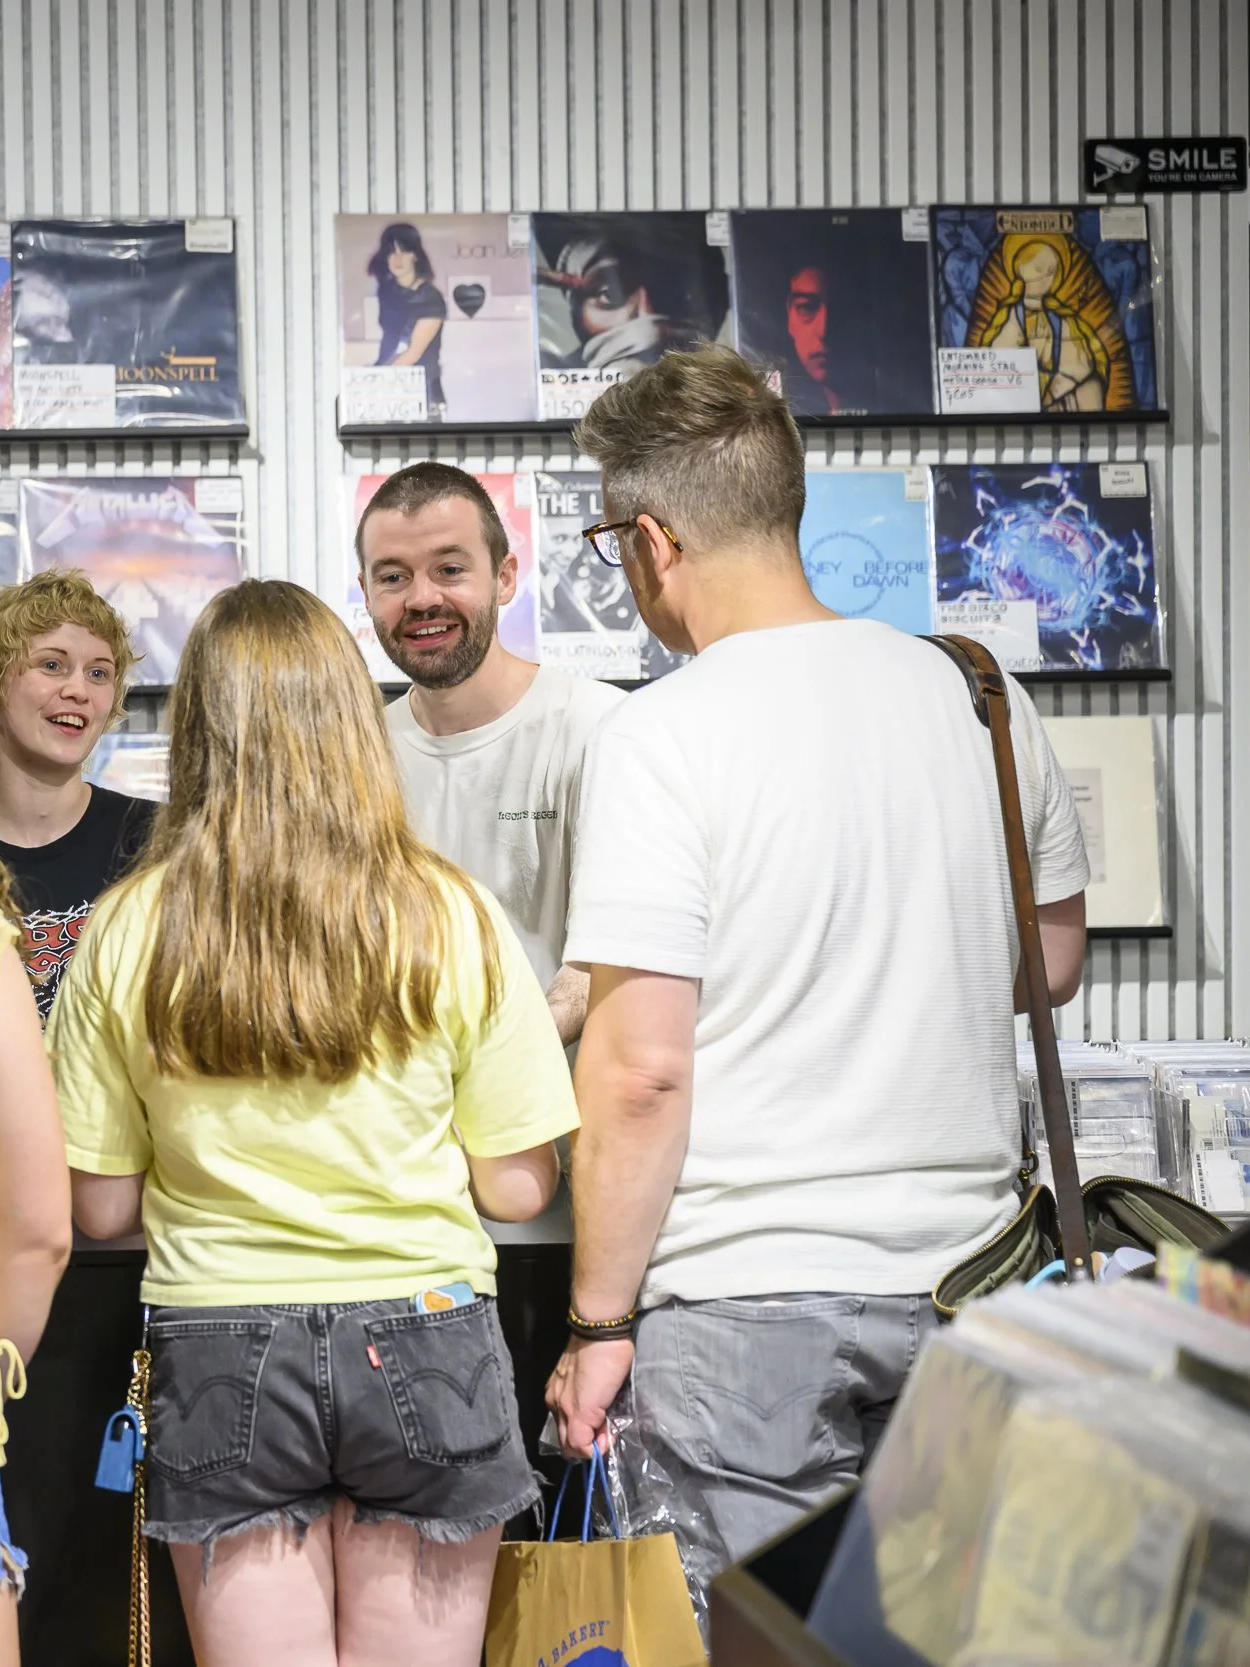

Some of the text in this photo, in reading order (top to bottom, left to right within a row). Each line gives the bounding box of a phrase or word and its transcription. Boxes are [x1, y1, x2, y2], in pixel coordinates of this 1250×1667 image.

[1148, 148, 1238, 171] SMILE
[1148, 171, 1238, 182] YOU'RE ON CAMERA
[537, 492, 580, 516] THE
[863, 560, 929, 576] BEFORE
[852, 574, 909, 589] DAWN
[551, 1620, 605, 1664] BAKERY
